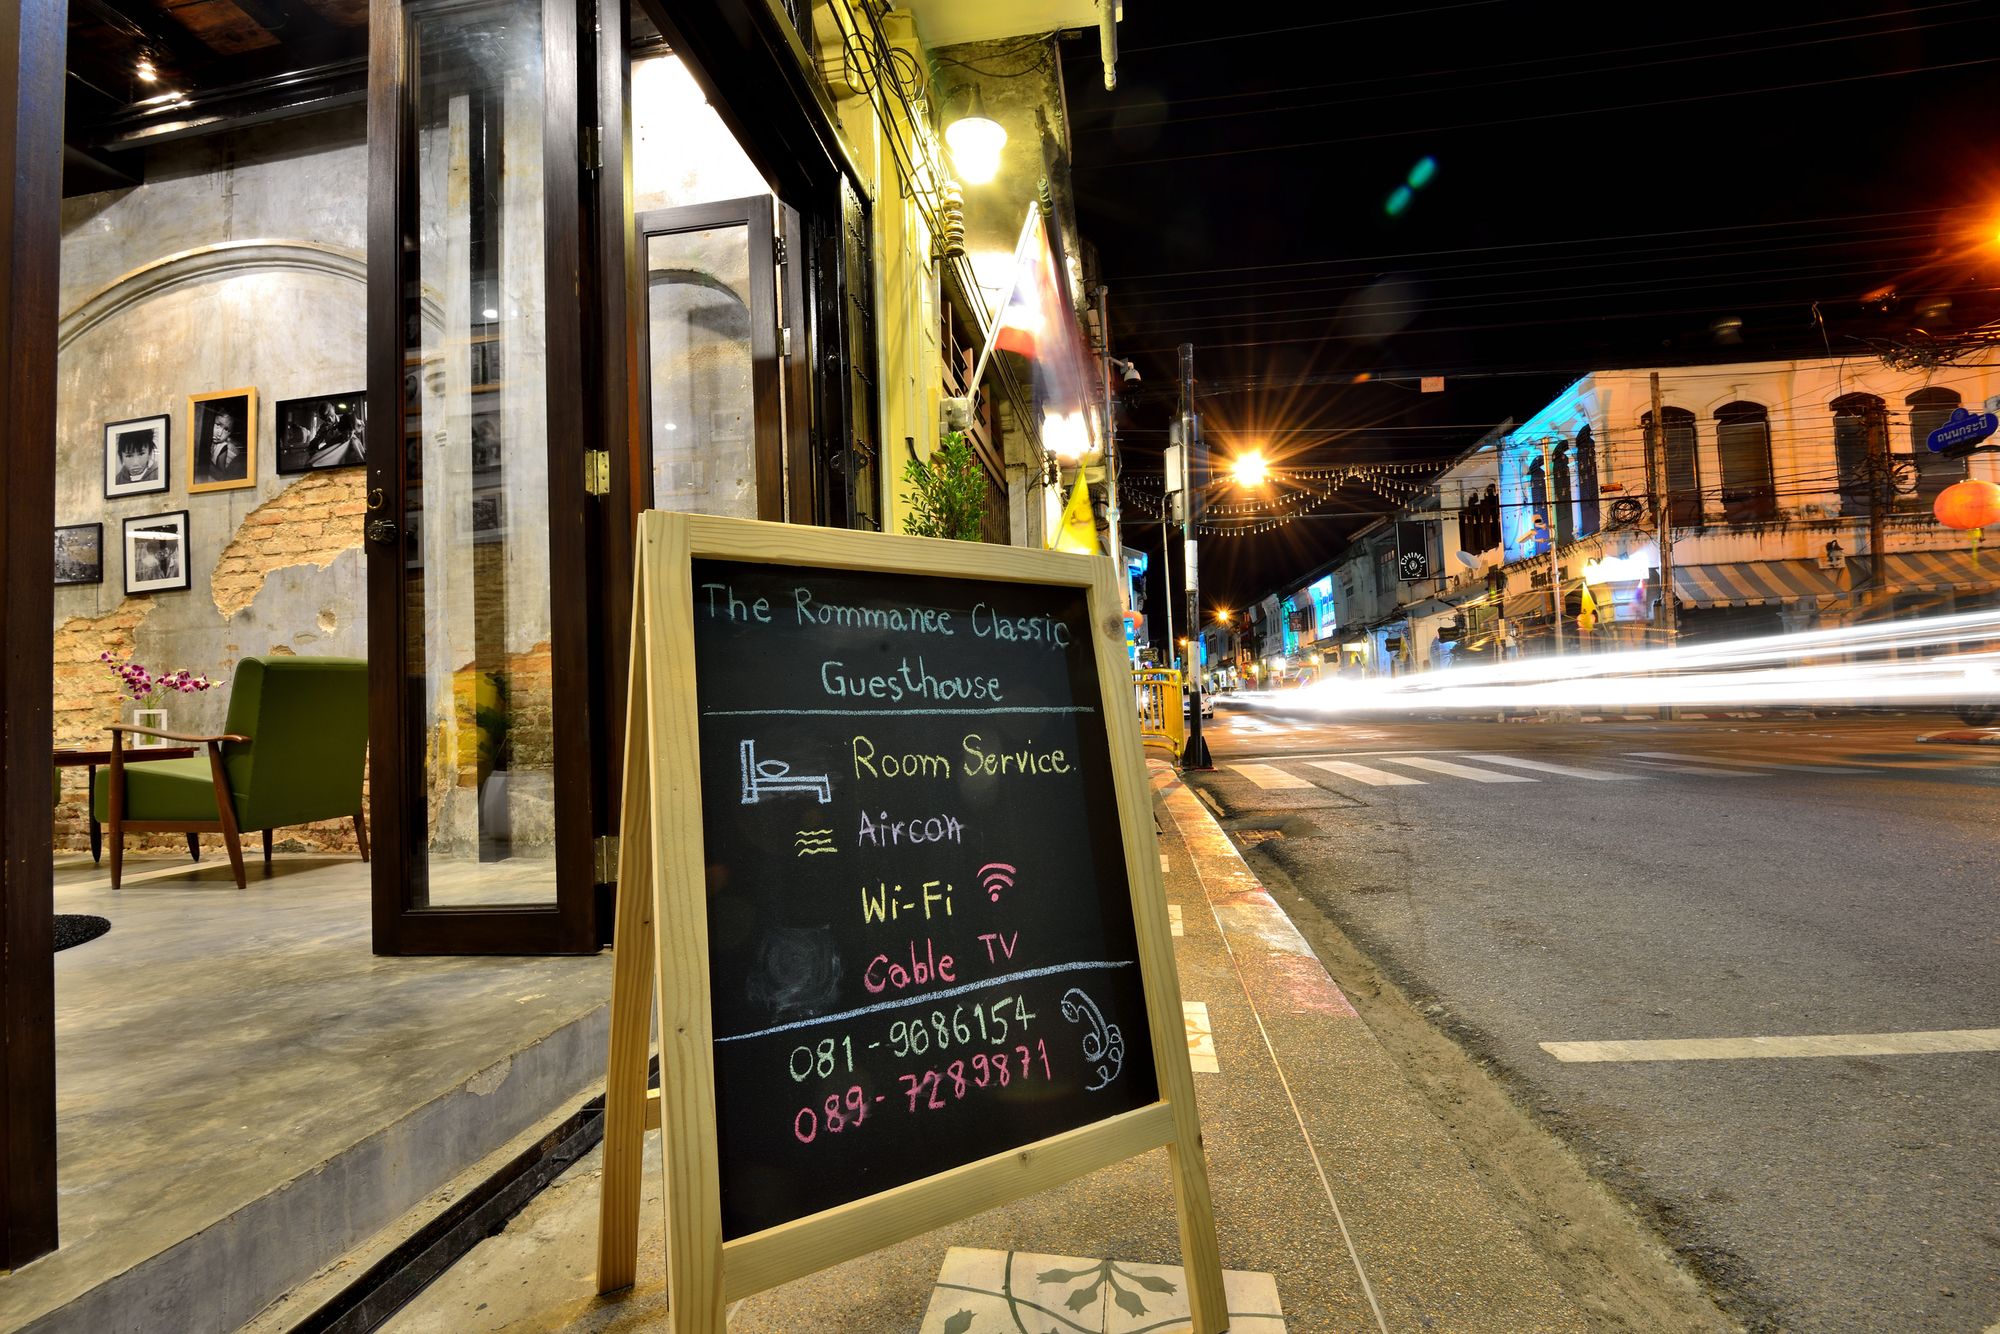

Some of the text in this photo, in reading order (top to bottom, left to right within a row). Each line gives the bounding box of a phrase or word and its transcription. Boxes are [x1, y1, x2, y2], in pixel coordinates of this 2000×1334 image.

[702, 583, 1070, 648] The Rommanee Classic
[821, 655, 1004, 703] Guesthouse
[852, 735, 951, 780] Room
[858, 810, 963, 848] Aircon
[861, 880, 954, 925] Wi-Fi
[863, 930, 1018, 994] Cable TV
